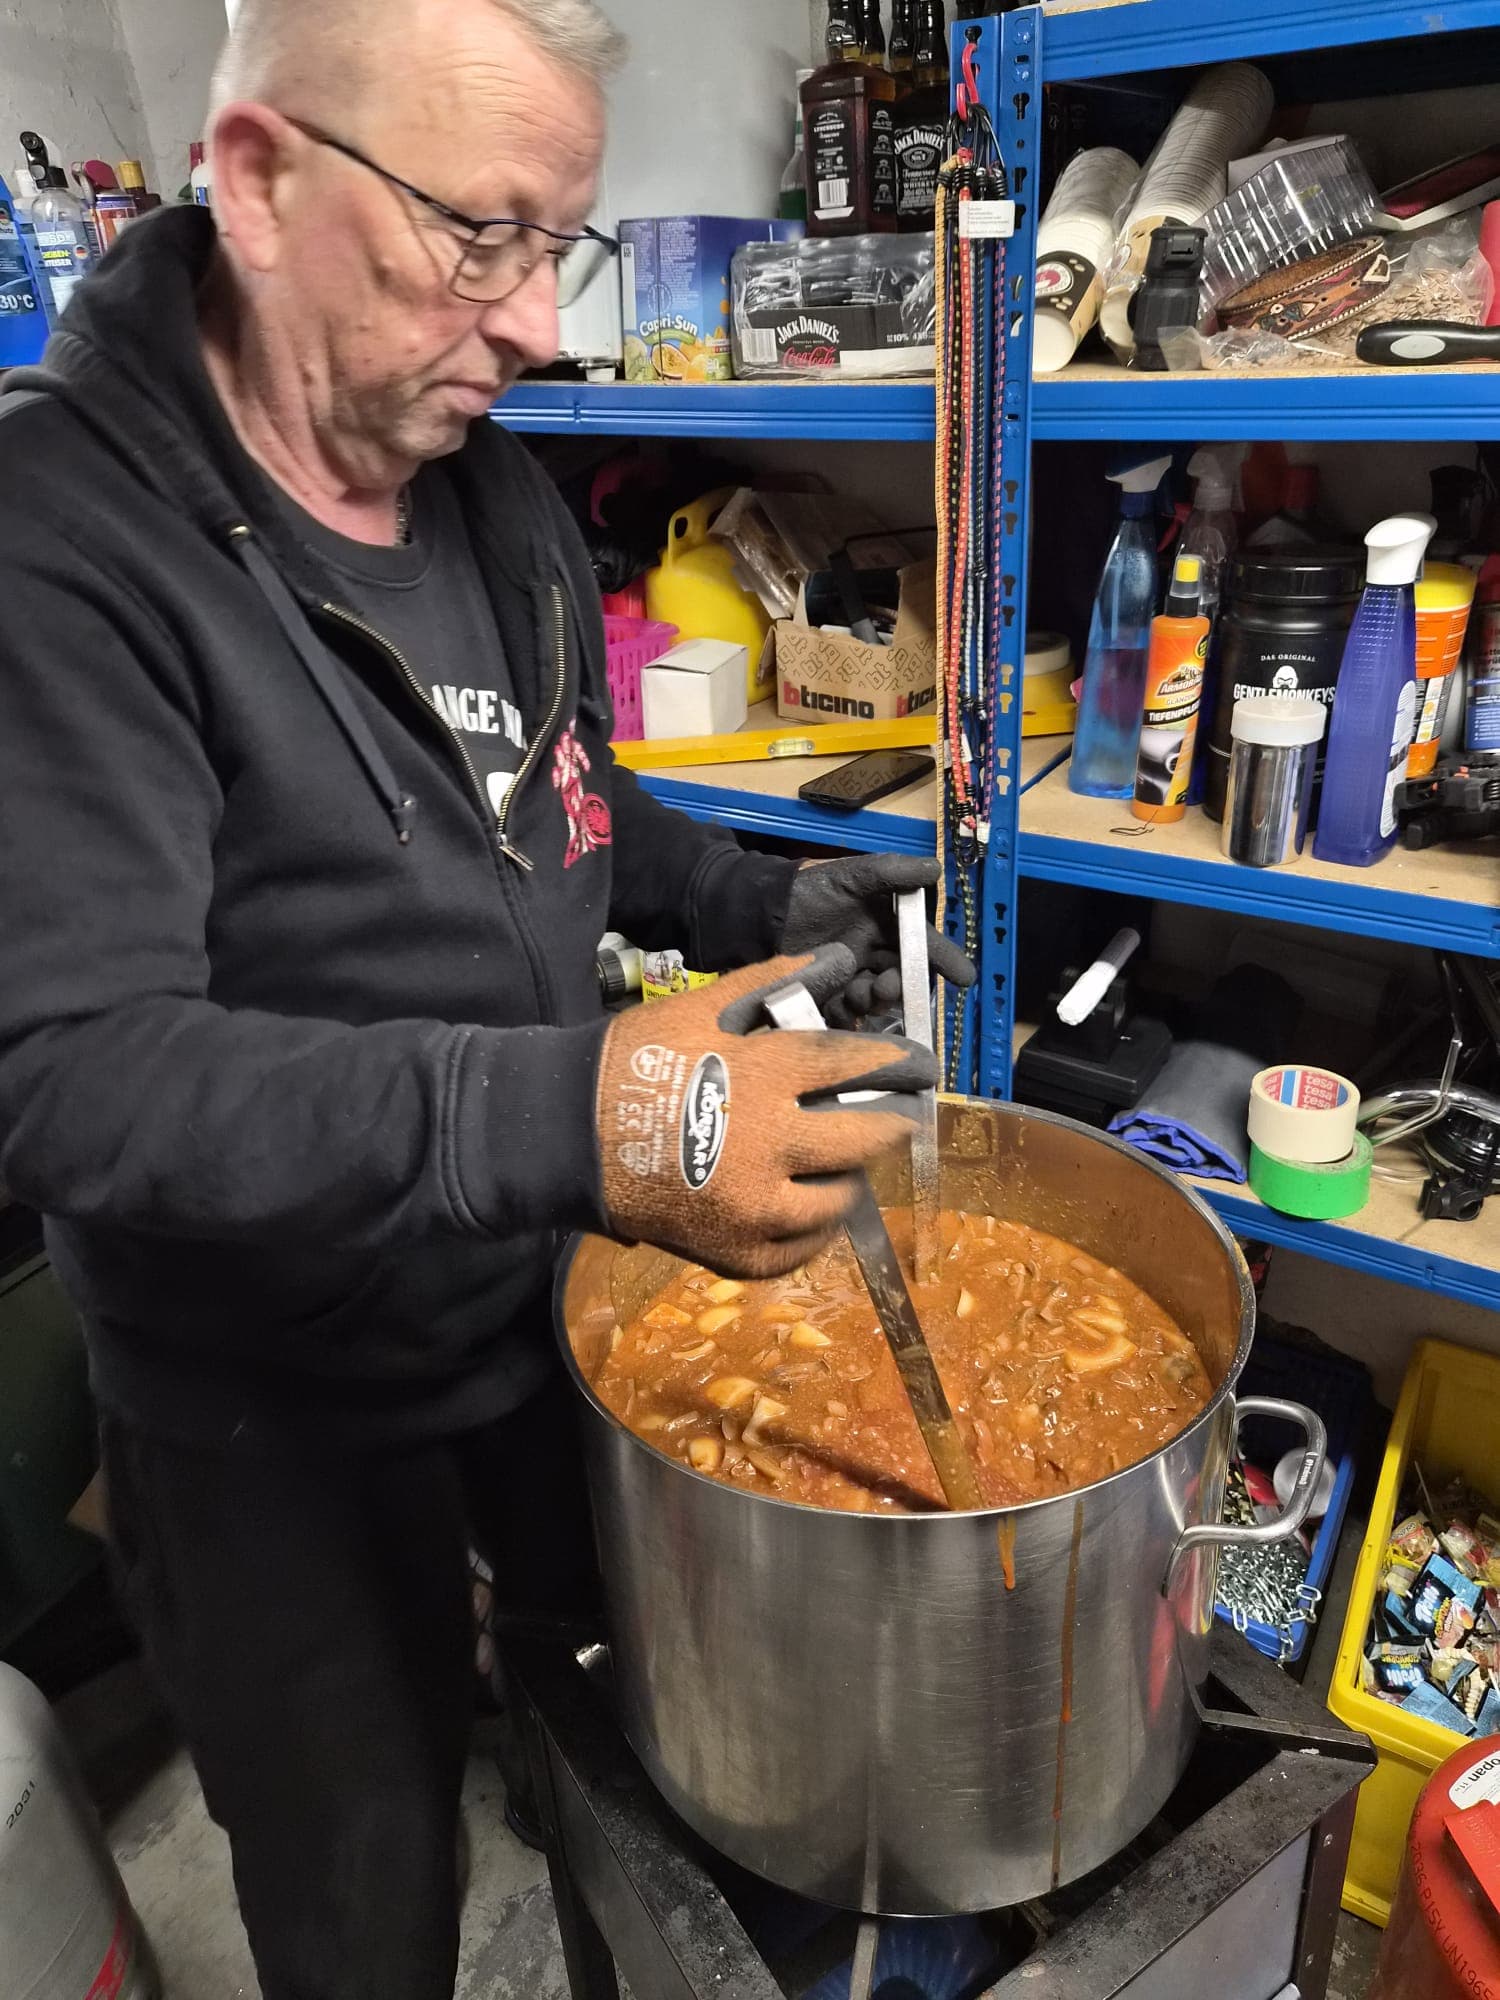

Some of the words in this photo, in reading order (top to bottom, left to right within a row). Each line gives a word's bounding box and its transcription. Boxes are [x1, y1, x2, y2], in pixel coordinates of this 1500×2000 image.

[894, 133, 913, 154] JACK
[913, 129, 945, 150] DANIEL'S
[639, 313, 698, 337] Capri-Sun
[776, 321, 800, 344] JACK
[781, 345, 836, 369] Coca-Cola
[1260, 654, 1276, 662] DAS
[1277, 653, 1316, 662] ORIGINAL
[783, 680, 875, 719] bticino
[1233, 683, 1336, 703] GENTLEMONKEYS
[1304, 1085, 1332, 1101] tesa
[1305, 1075, 1333, 1090] tesa
[1303, 1094, 1331, 1110] tesa
[692, 1081, 718, 1166] KORSAR
[1386, 1666, 1425, 1688] Trolli
[1467, 1757, 1500, 1782] opan
[6, 1780, 35, 1829] 2031
